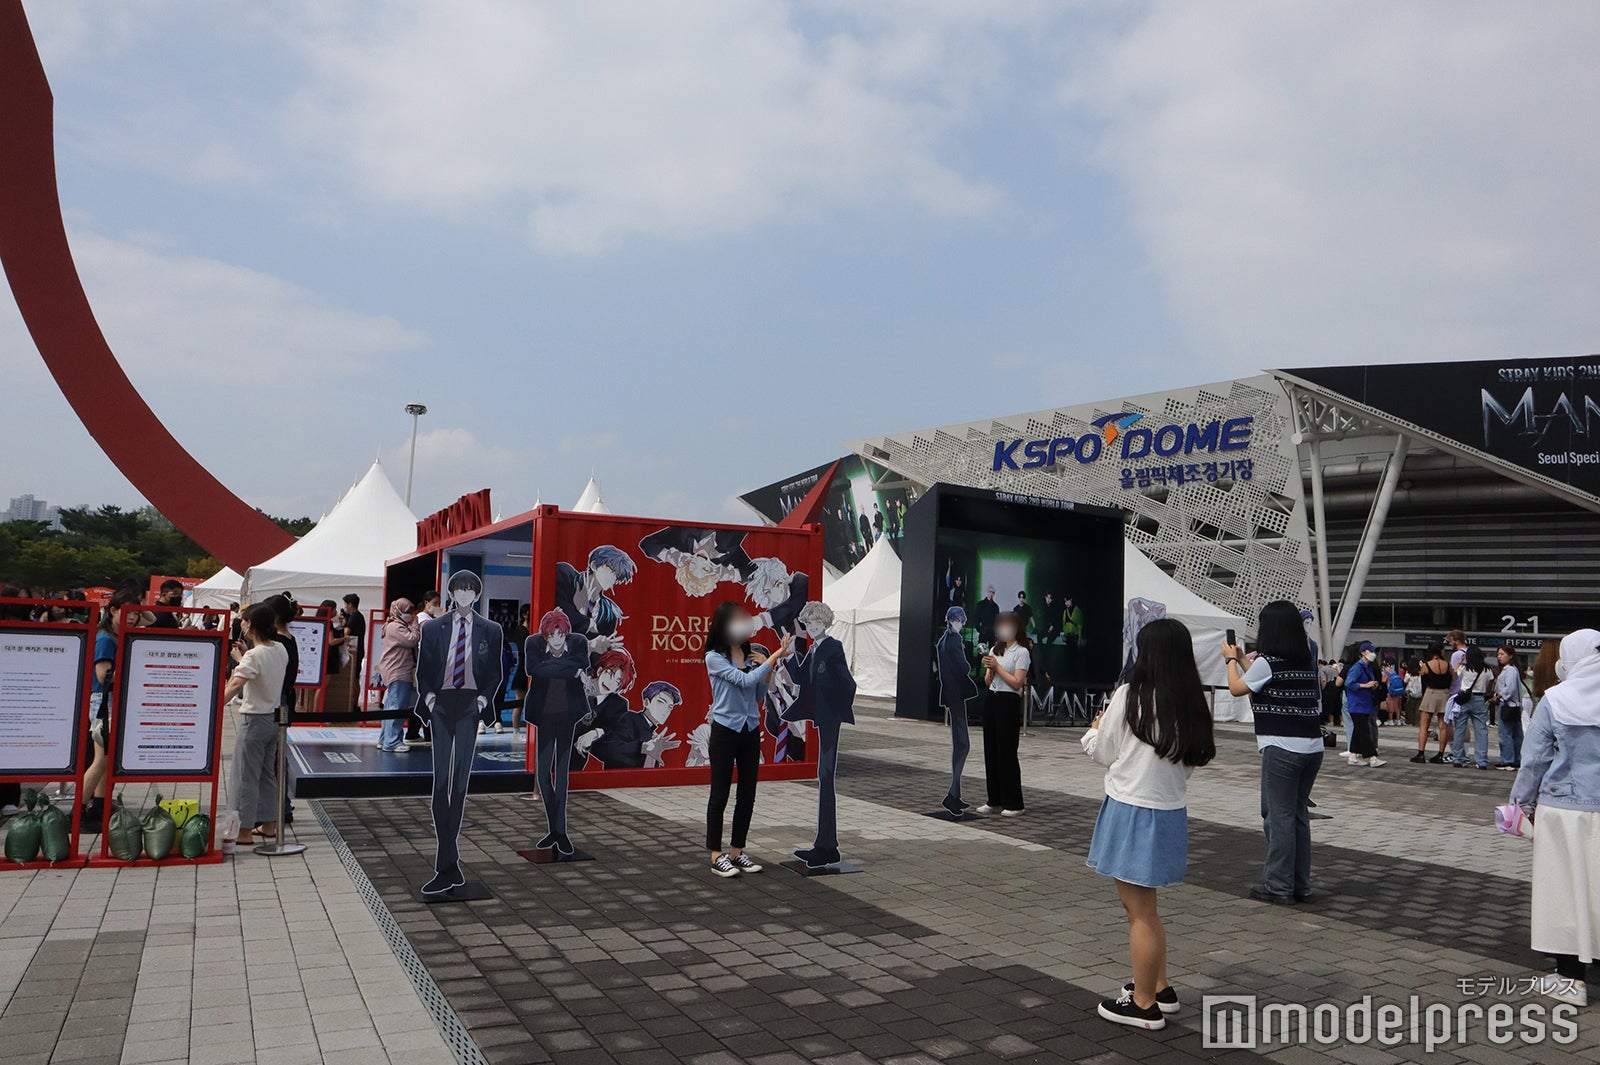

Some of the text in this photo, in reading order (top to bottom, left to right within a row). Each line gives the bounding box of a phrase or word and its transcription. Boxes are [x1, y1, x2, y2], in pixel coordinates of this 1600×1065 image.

[1498, 367, 1540, 382] STRAY
[1543, 365, 1575, 381] KIDS
[993, 416, 1254, 472] KSPO DOME
[1538, 451, 1568, 465] Seoul
[1118, 459, 1255, 489] 올림픽체조경기장
[1501, 615, 1539, 634] 2-1
